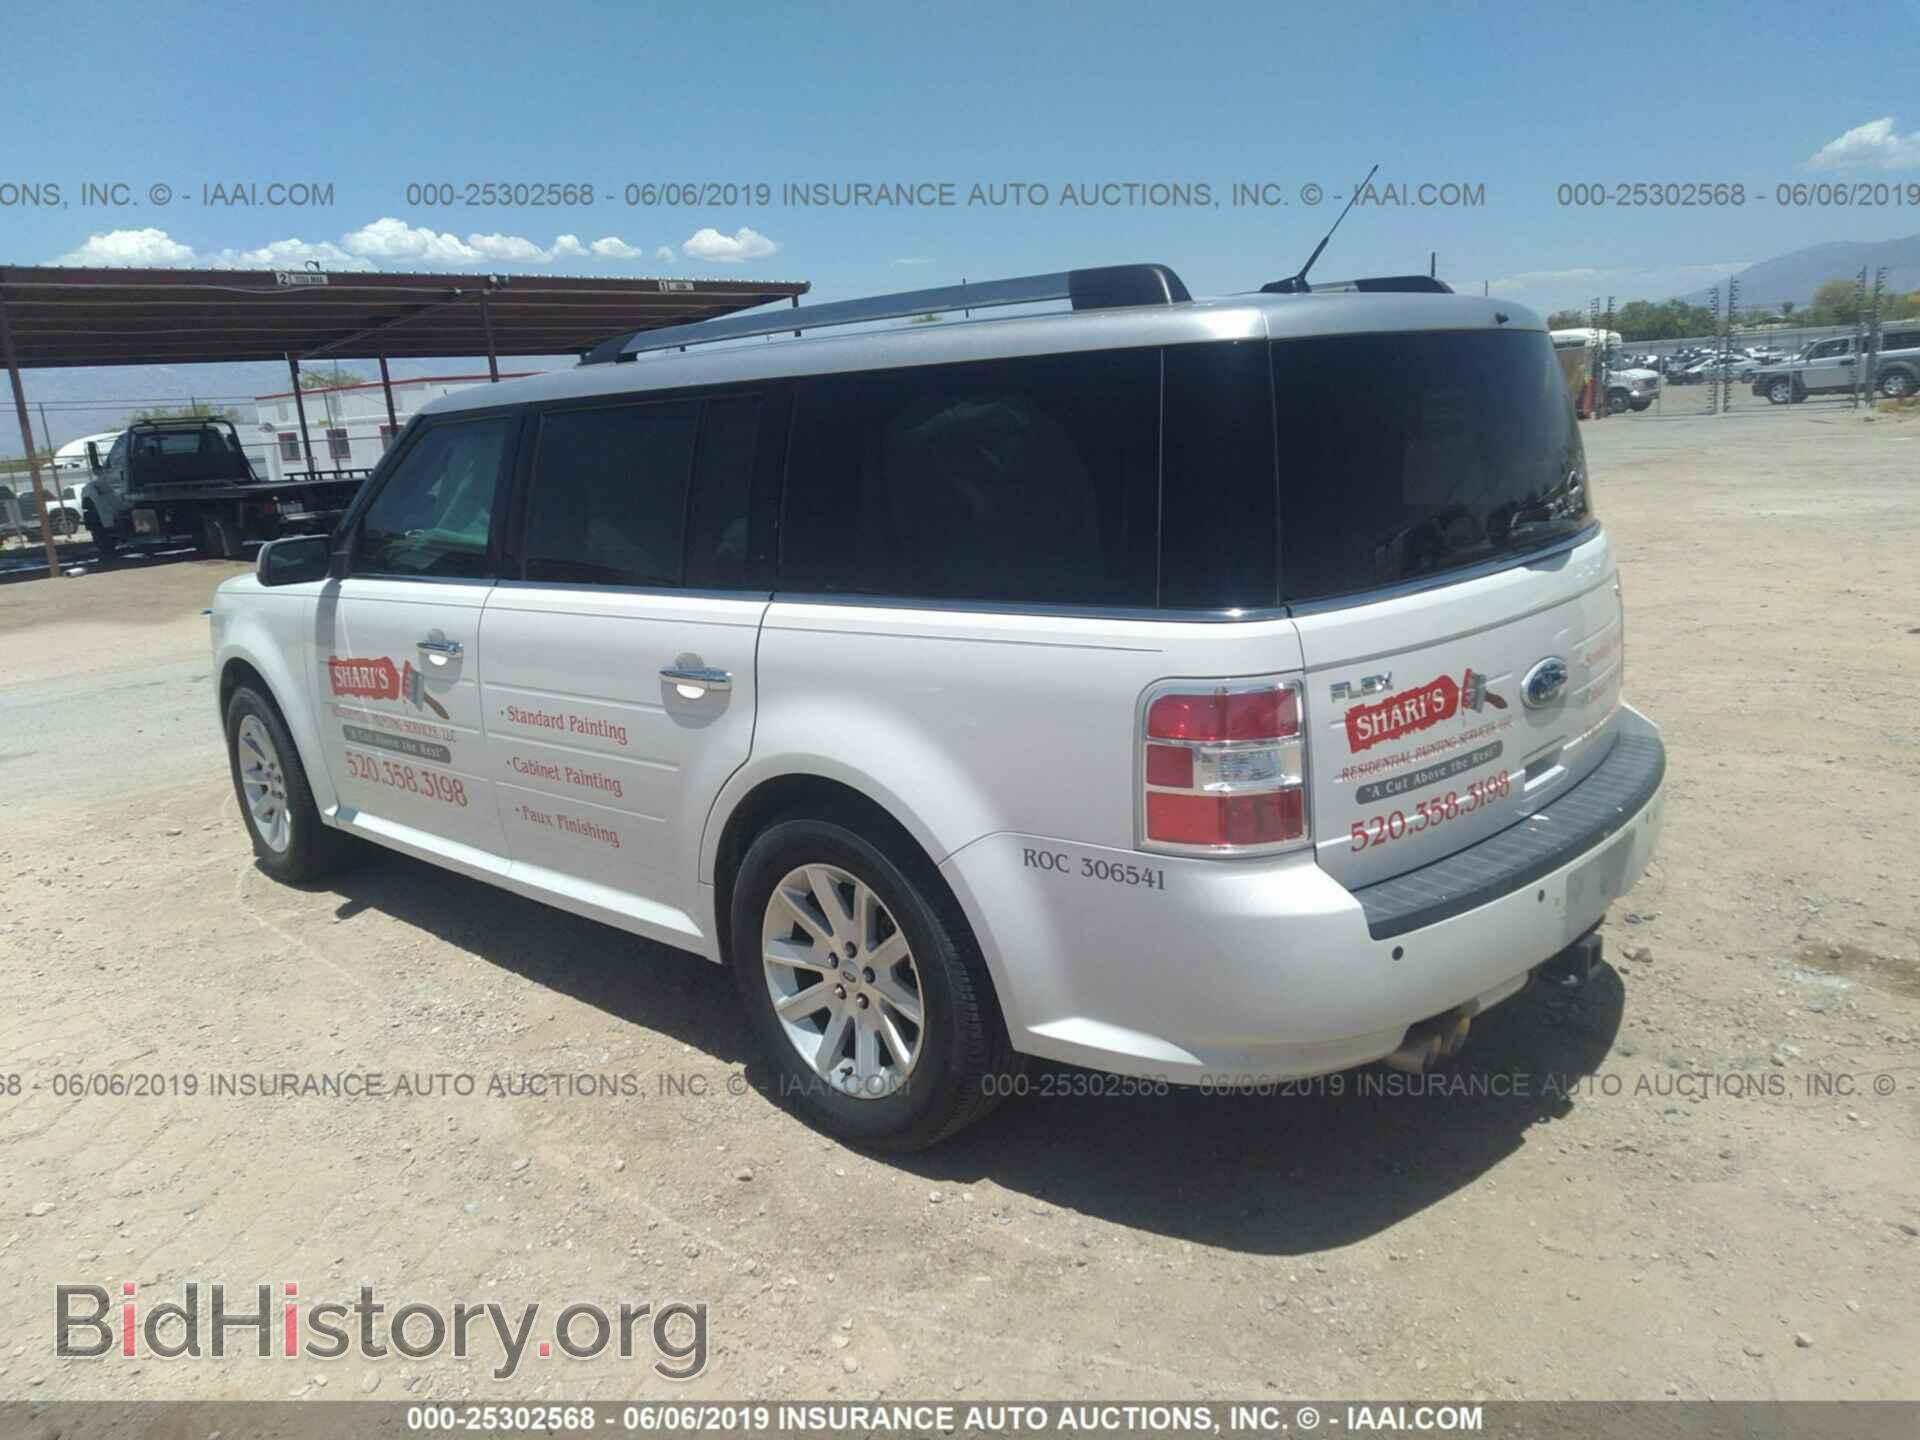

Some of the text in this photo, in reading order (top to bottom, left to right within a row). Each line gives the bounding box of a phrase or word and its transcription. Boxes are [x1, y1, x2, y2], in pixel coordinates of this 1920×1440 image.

[334, 666, 389, 690] SHARI'S
[1330, 671, 1393, 703] FLEX
[507, 705, 628, 745] Standard Painting
[1356, 687, 1446, 740] SHARI'S
[346, 752, 468, 808] 520.358.3198
[513, 757, 623, 797] Cabinet Painting
[1386, 778, 1409, 795] Cut
[1414, 766, 1446, 788] Above
[1350, 769, 1511, 853] 520.358.3198
[557, 814, 621, 849] Finishing
[1024, 848, 1166, 890] ROC 306541
